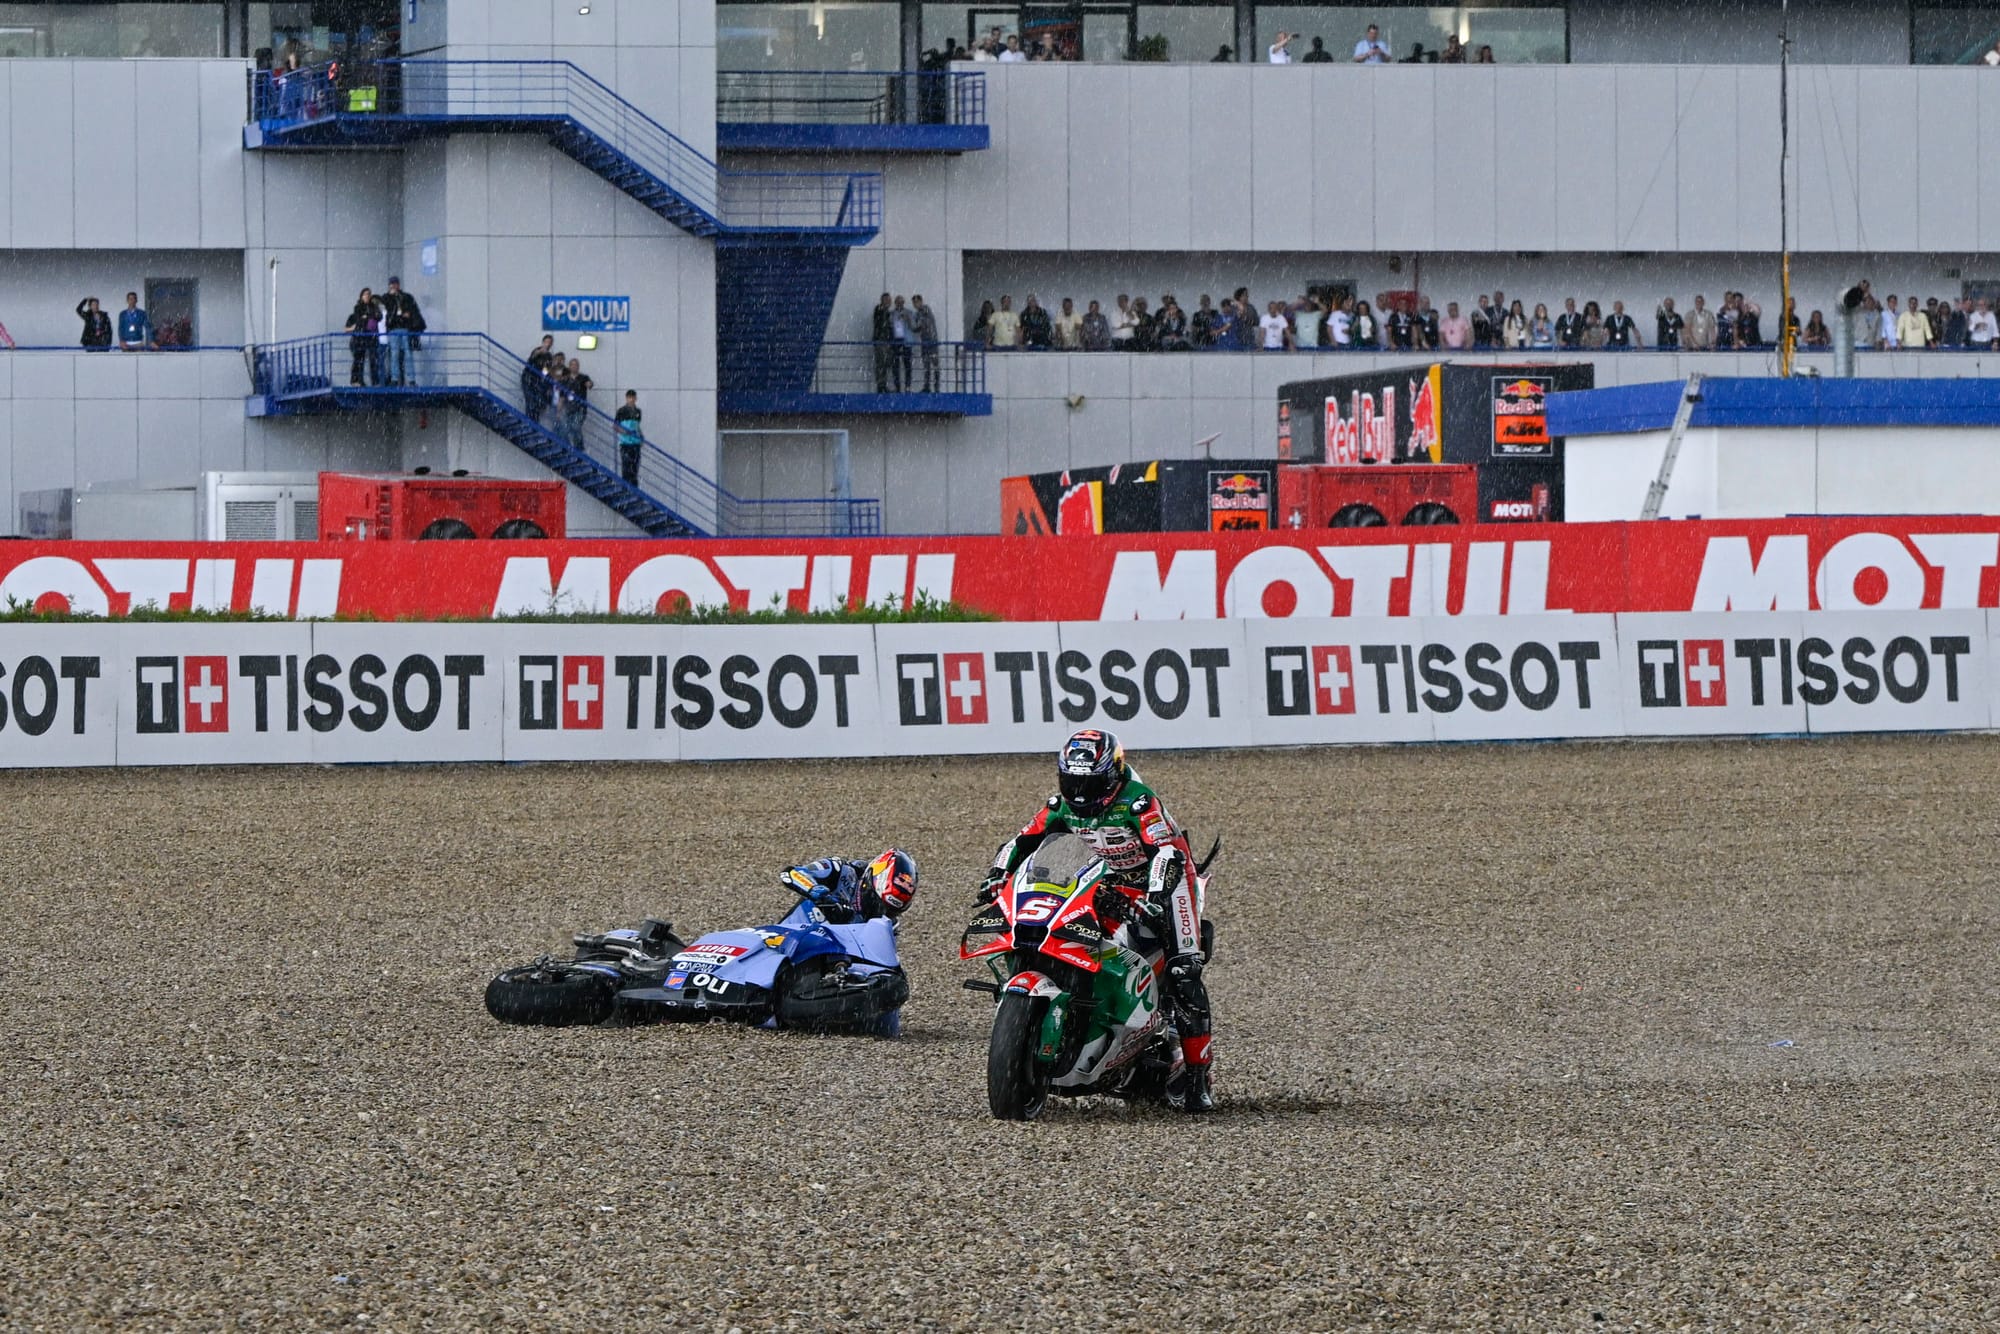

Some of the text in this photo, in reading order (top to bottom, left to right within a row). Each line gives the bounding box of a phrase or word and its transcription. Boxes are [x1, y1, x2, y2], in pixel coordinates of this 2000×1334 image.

[556, 300, 627, 322] PODIUM
[1325, 389, 1359, 464] Red
[1361, 386, 1395, 464] Bull
[1495, 399, 1523, 414] Red
[1211, 493, 1268, 509] Red Bull
[492, 554, 956, 617] MOTUL
[1100, 540, 1573, 619] MOTUL
[0, 655, 100, 736] OT
[239, 654, 485, 733] TISSOT
[615, 654, 859, 730] TISSOT
[994, 647, 1229, 723] TISSOT
[1359, 641, 1600, 714] TISSOT
[1734, 635, 1970, 707] TISSOT
[1176, 896, 1192, 936] Castrol
[692, 973, 730, 995] OLI
